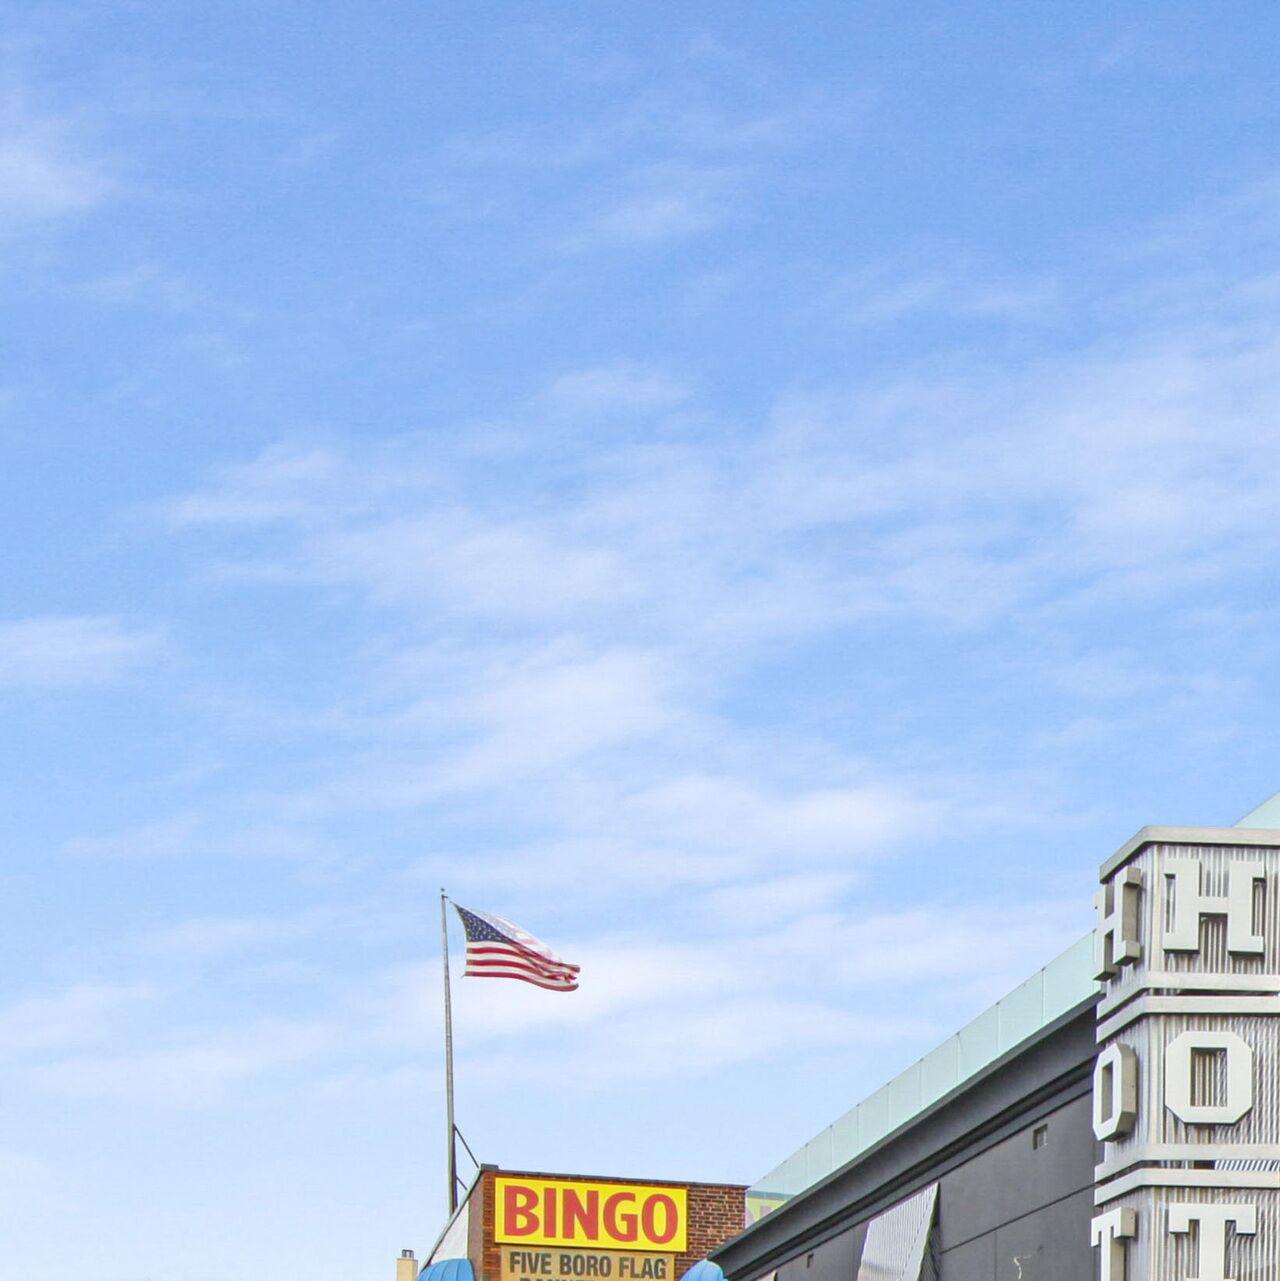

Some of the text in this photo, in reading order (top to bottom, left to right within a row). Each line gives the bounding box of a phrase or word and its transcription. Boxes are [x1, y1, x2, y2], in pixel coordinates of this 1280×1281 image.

[504, 1184, 678, 1244] BINGO
[509, 1251, 667, 1280] FIVE BORO FLAG
